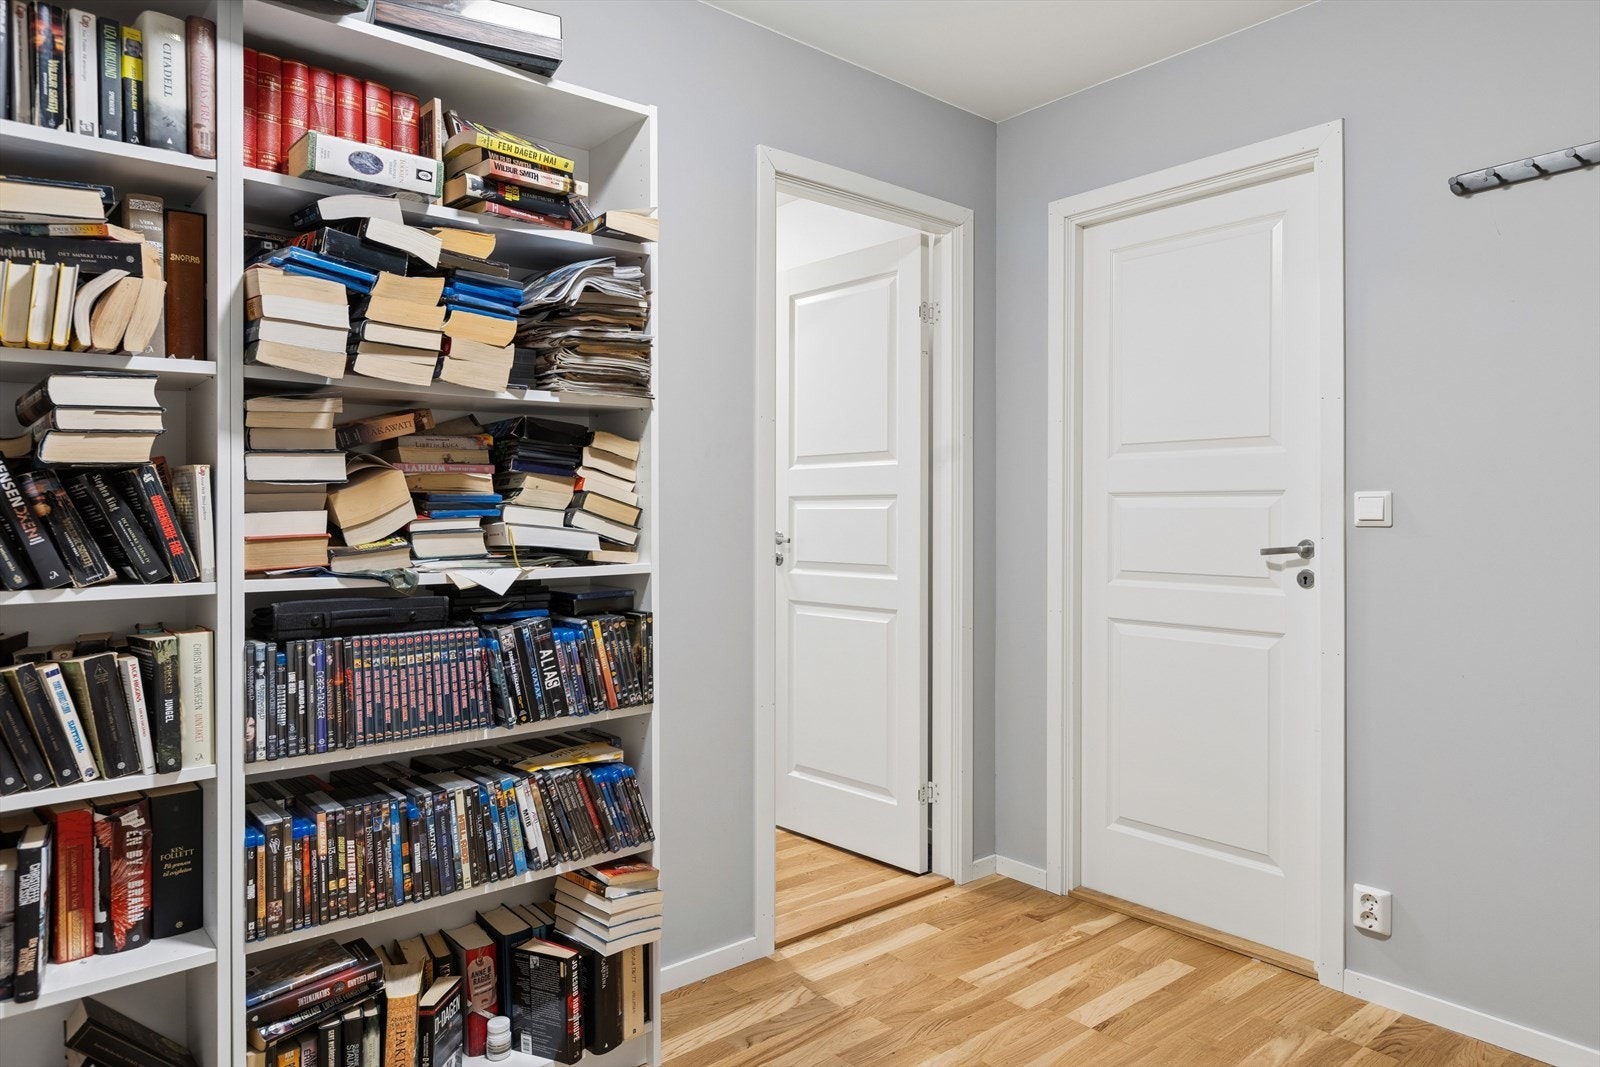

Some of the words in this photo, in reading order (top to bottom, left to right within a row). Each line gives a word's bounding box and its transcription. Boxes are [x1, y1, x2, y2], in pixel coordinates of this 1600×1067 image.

[104, 24, 116, 40] LIZA
[104, 40, 117, 78] MARKLUND
[162, 43, 172, 97] CITADELL
[48, 60, 60, 88] WILBUR
[199, 52, 210, 99] AURELIAS
[46, 90, 58, 114] SMITH
[498, 142, 512, 152] FEM
[514, 147, 537, 160] DAGER
[543, 155, 557, 165] MAI
[494, 161, 518, 175] WILBUR
[519, 170, 538, 182] SMITH
[28, 248, 47, 261] King
[368, 420, 413, 437] AKAWATI
[404, 464, 446, 472] LAHLUM
[93, 474, 111, 497] Stephen
[104, 497, 120, 512] King
[169, 540, 184, 556] FARE
[129, 663, 138, 678] JACK
[193, 644, 202, 674] CHRISTIAN
[539, 649, 560, 690] ALIAS
[133, 680, 142, 702] HIGGINS
[193, 675, 202, 710] JUNGERSEN
[530, 667, 541, 699] AVATAR
[165, 699, 174, 723] JUNGEL
[277, 684, 286, 726] BATTLESHIP
[195, 714, 203, 743] UNNTAKET
[126, 830, 144, 846] EN
[429, 824, 437, 860] MUTANT
[126, 850, 144, 866] BY
[160, 849, 194, 861] FOLLETT
[347, 840, 356, 862] DEATH
[460, 839, 469, 864] RIDE
[348, 863, 356, 879] RACE
[19, 873, 30, 906] CARLSSON
[28, 862, 41, 904] CHRISTOFFER
[127, 878, 144, 924] BRANN
[367, 970, 377, 981] TOM
[471, 968, 486, 979] ANNE
[572, 960, 578, 970] JO
[347, 973, 367, 988] EGELAND
[472, 973, 492, 985] RAGDE
[434, 994, 461, 1034] D-DAGEN
